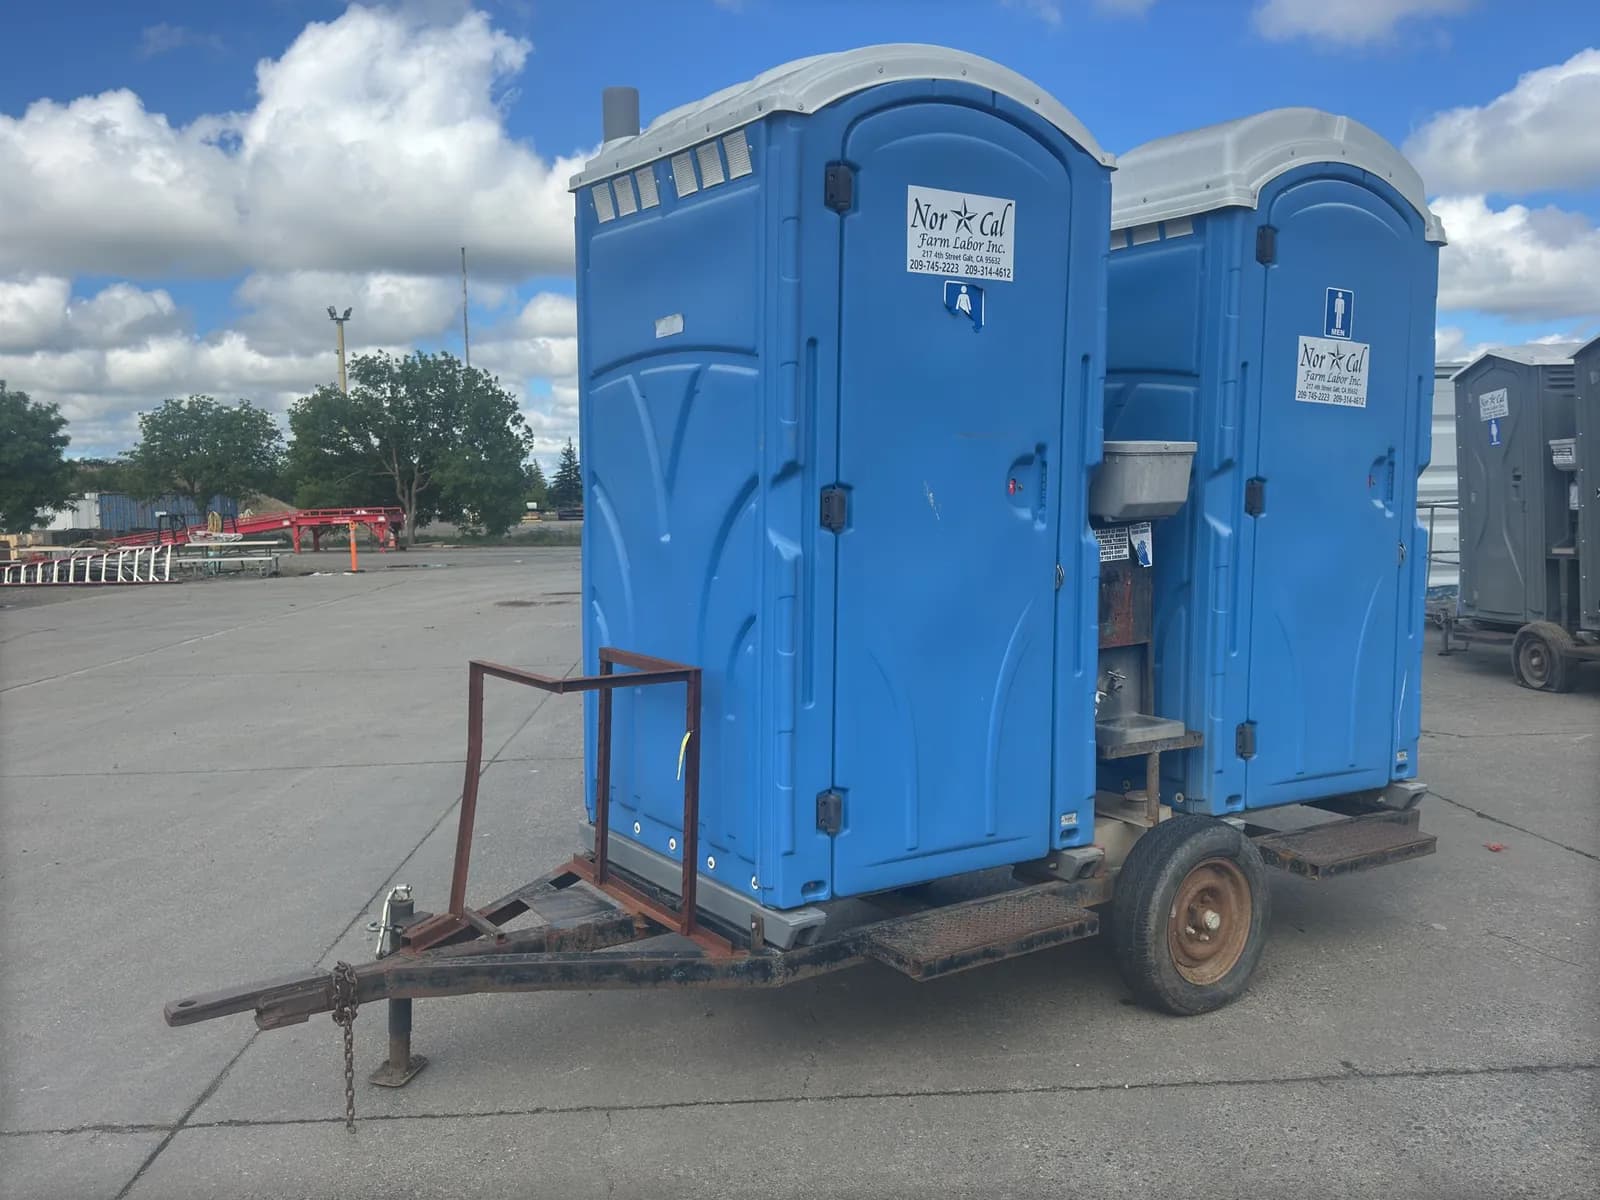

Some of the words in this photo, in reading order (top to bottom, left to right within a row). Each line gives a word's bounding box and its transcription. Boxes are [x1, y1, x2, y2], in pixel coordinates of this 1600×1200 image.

[911, 198, 948, 231] Nor
[980, 203, 1012, 238] Cal
[918, 233, 950, 248] Farm
[953, 236, 984, 252] Labor
[986, 240, 1006, 254] Inc.
[922, 250, 932, 258] 217
[934, 251, 943, 259] 4th
[945, 252, 961, 261] Street
[976, 255, 984, 263] CA
[985, 256, 1001, 265] 95632
[910, 259, 959, 274] 209-745-2223
[965, 264, 1011, 278] 209-314-4612
[1300, 343, 1326, 369] Nor
[1346, 346, 1368, 373] Cal
[1304, 370, 1326, 382] Farm
[1326, 372, 1348, 385] Labor
